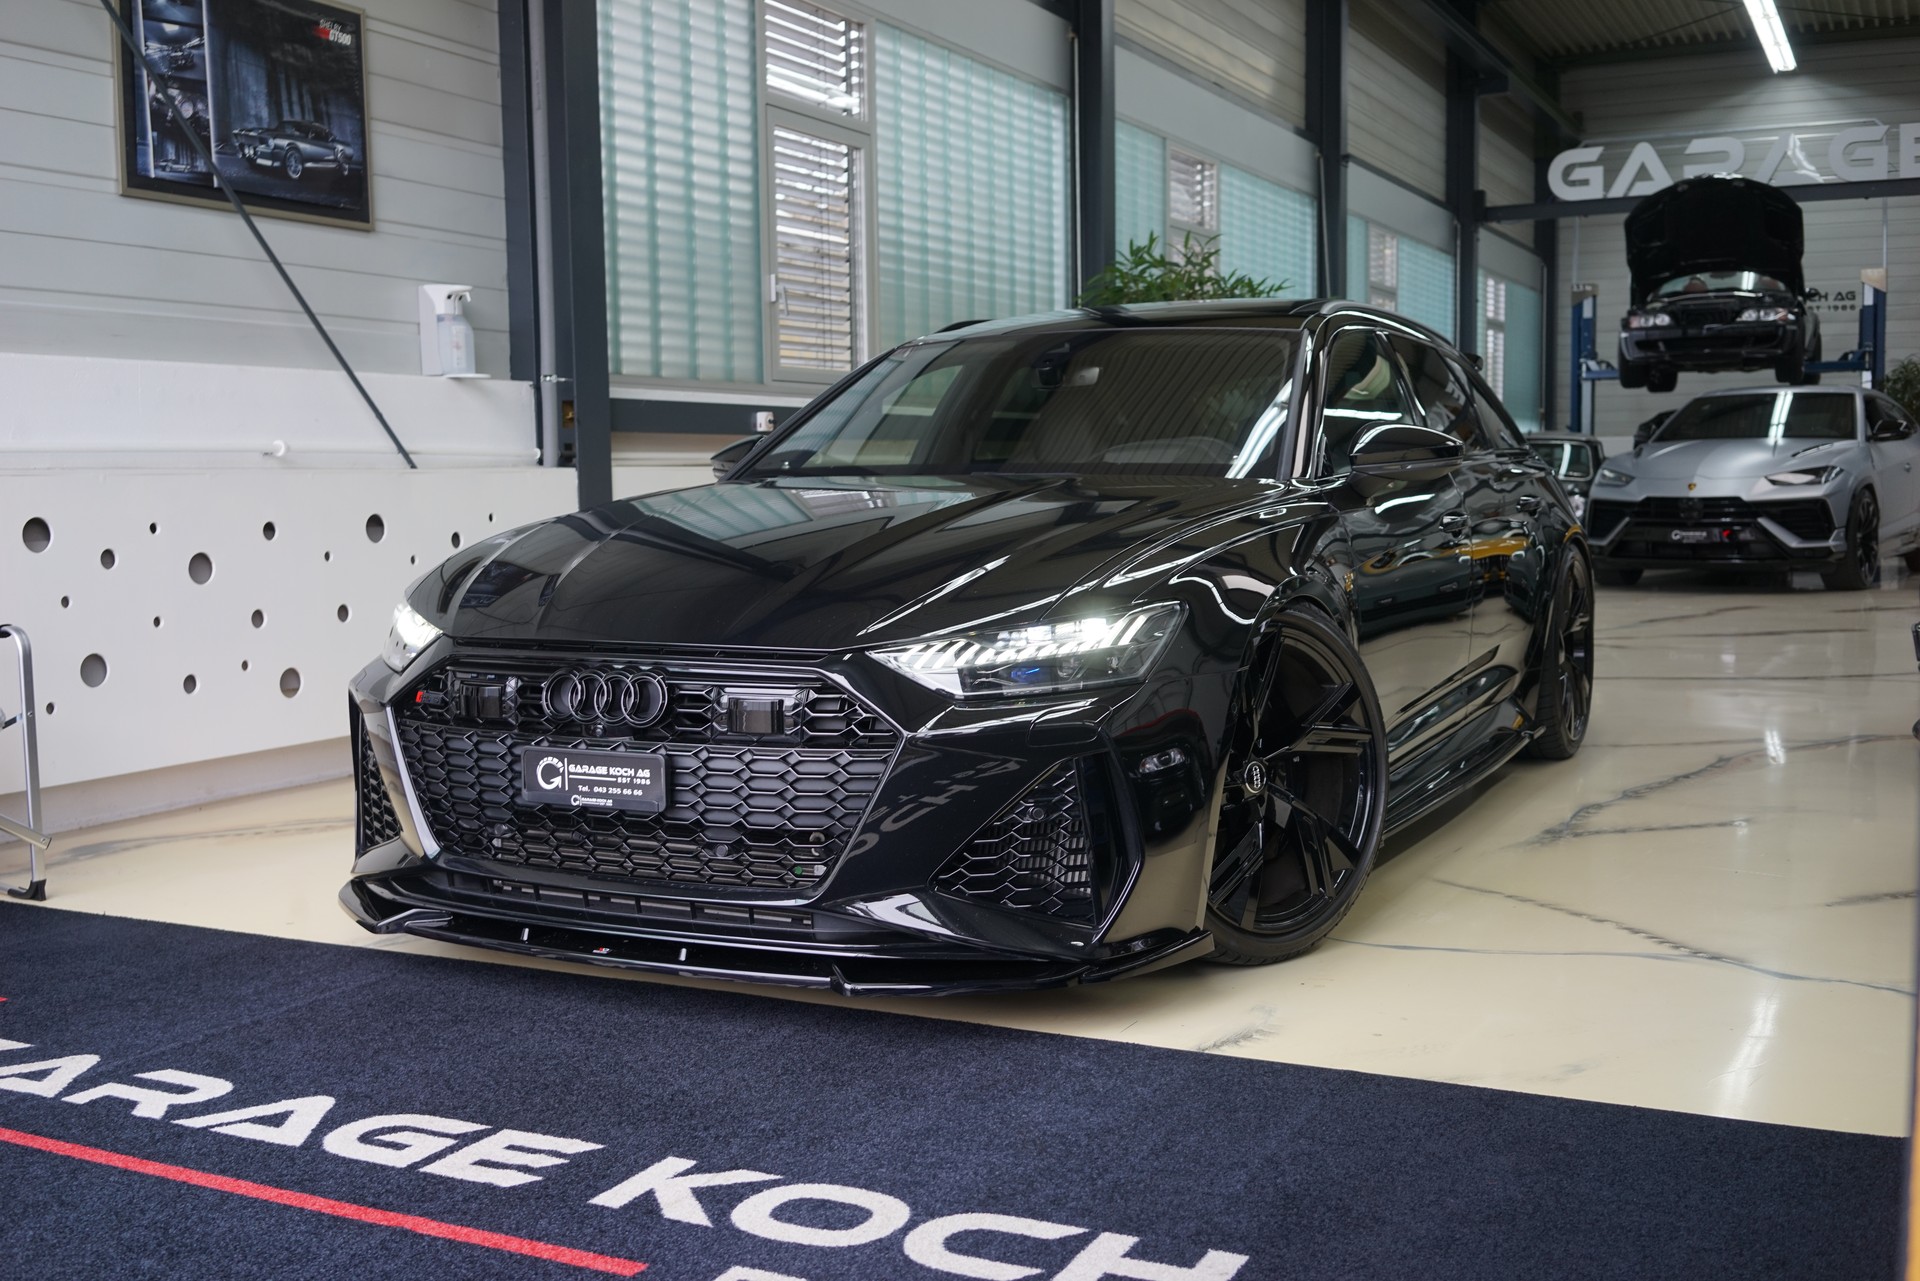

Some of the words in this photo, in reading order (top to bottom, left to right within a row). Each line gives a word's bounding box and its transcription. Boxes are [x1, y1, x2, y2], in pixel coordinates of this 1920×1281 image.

[1833, 291, 1857, 302] AG
[568, 764, 608, 775] GARAGE
[609, 766, 634, 777] KOCH
[636, 768, 651, 778] AG
[633, 777, 651, 785] 1986
[608, 787, 621, 795] 255
[0, 1038, 605, 1188] ARAGE
[587, 1156, 1249, 1281] KOCH
